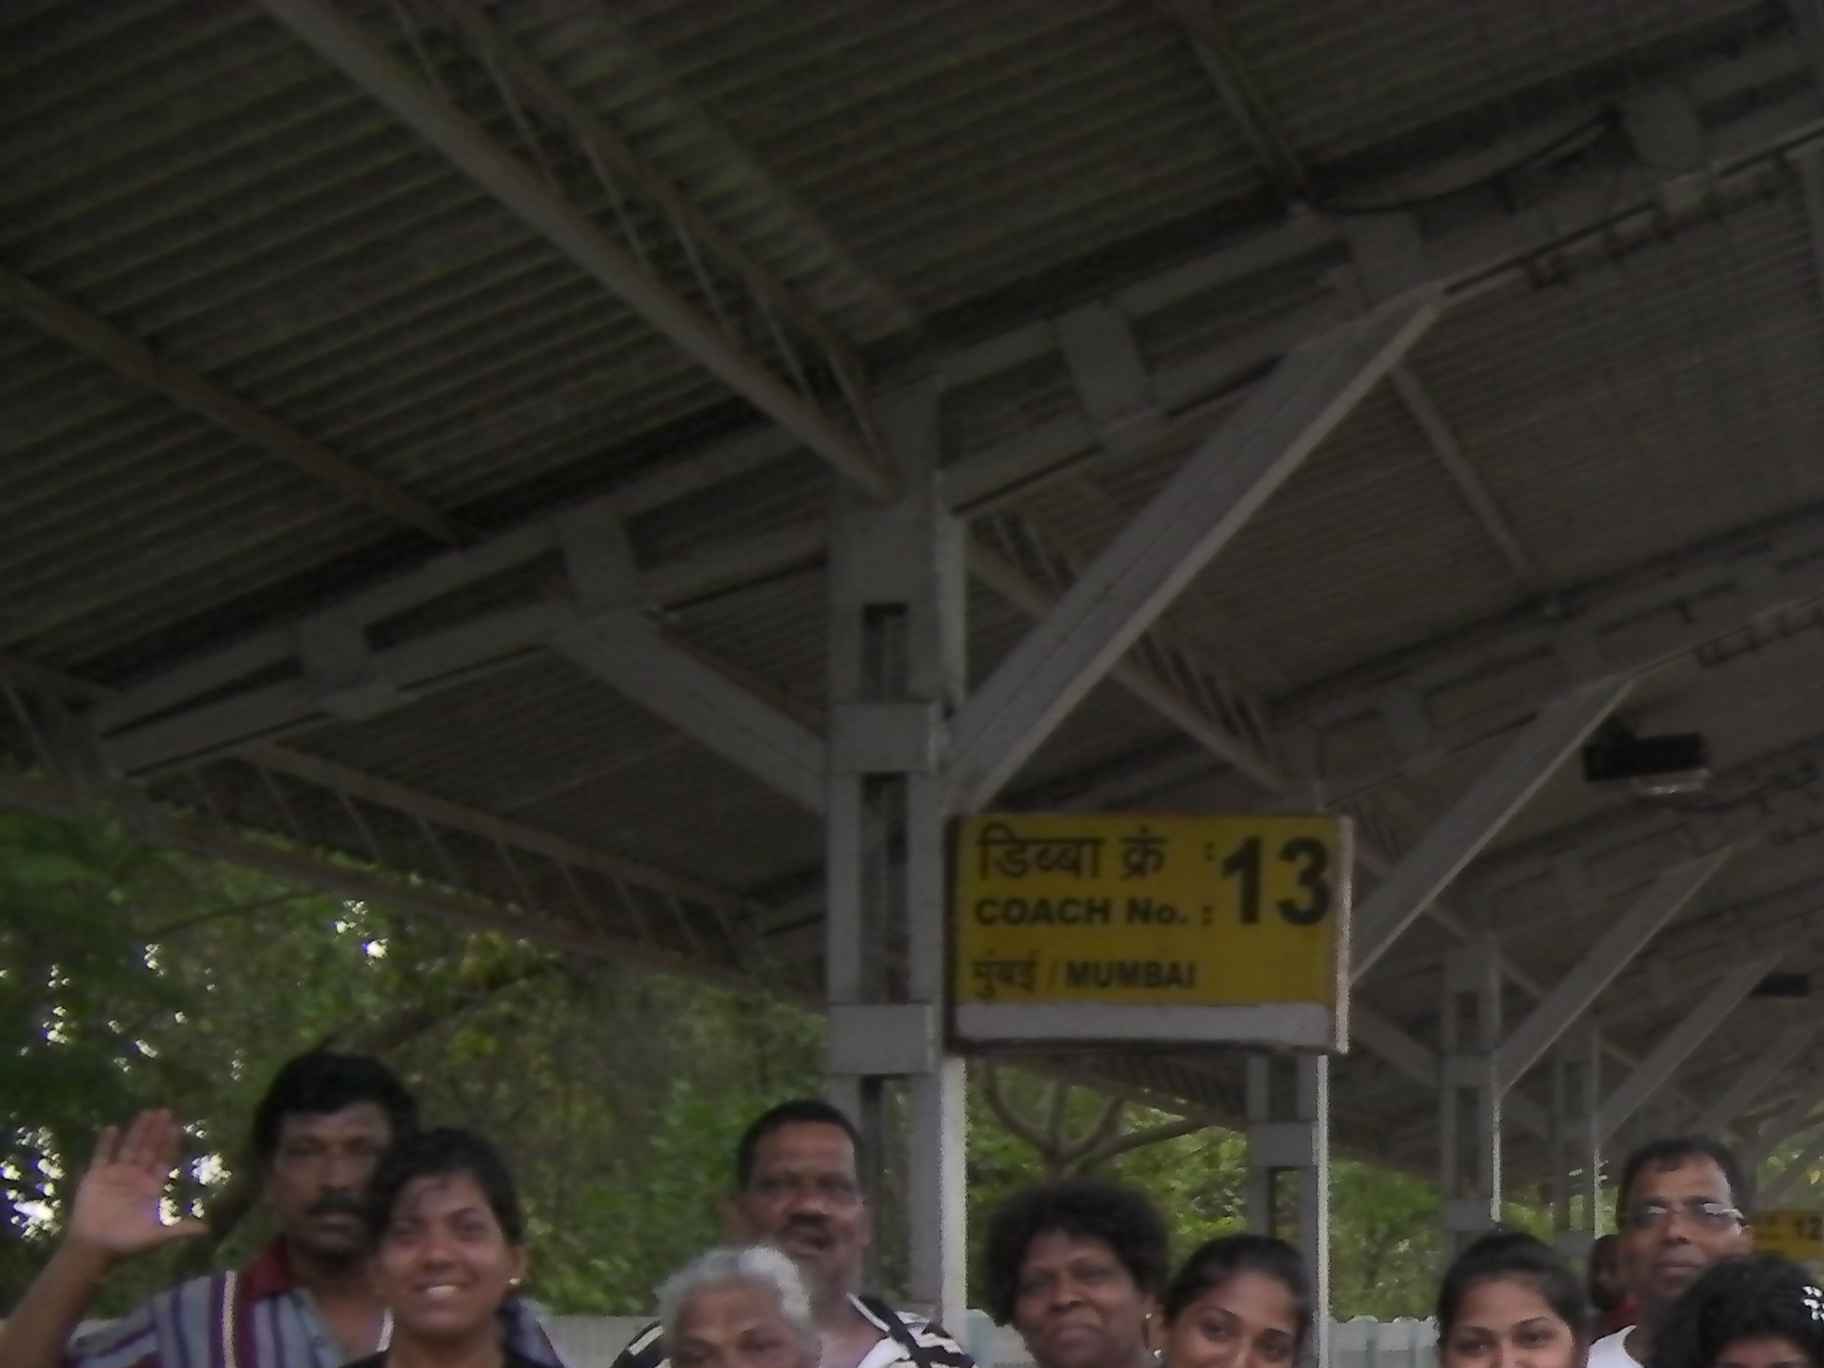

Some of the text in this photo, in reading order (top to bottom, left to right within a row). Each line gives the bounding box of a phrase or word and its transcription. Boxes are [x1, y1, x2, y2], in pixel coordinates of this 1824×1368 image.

[977, 823, 1105, 879] डिब्बा
[1221, 835, 1331, 926] 13
[974, 898, 1111, 926] COACH
[1126, 898, 1187, 926] No.
[972, 950, 1039, 999] मुंबई
[1065, 961, 1196, 989] MUMBAI
